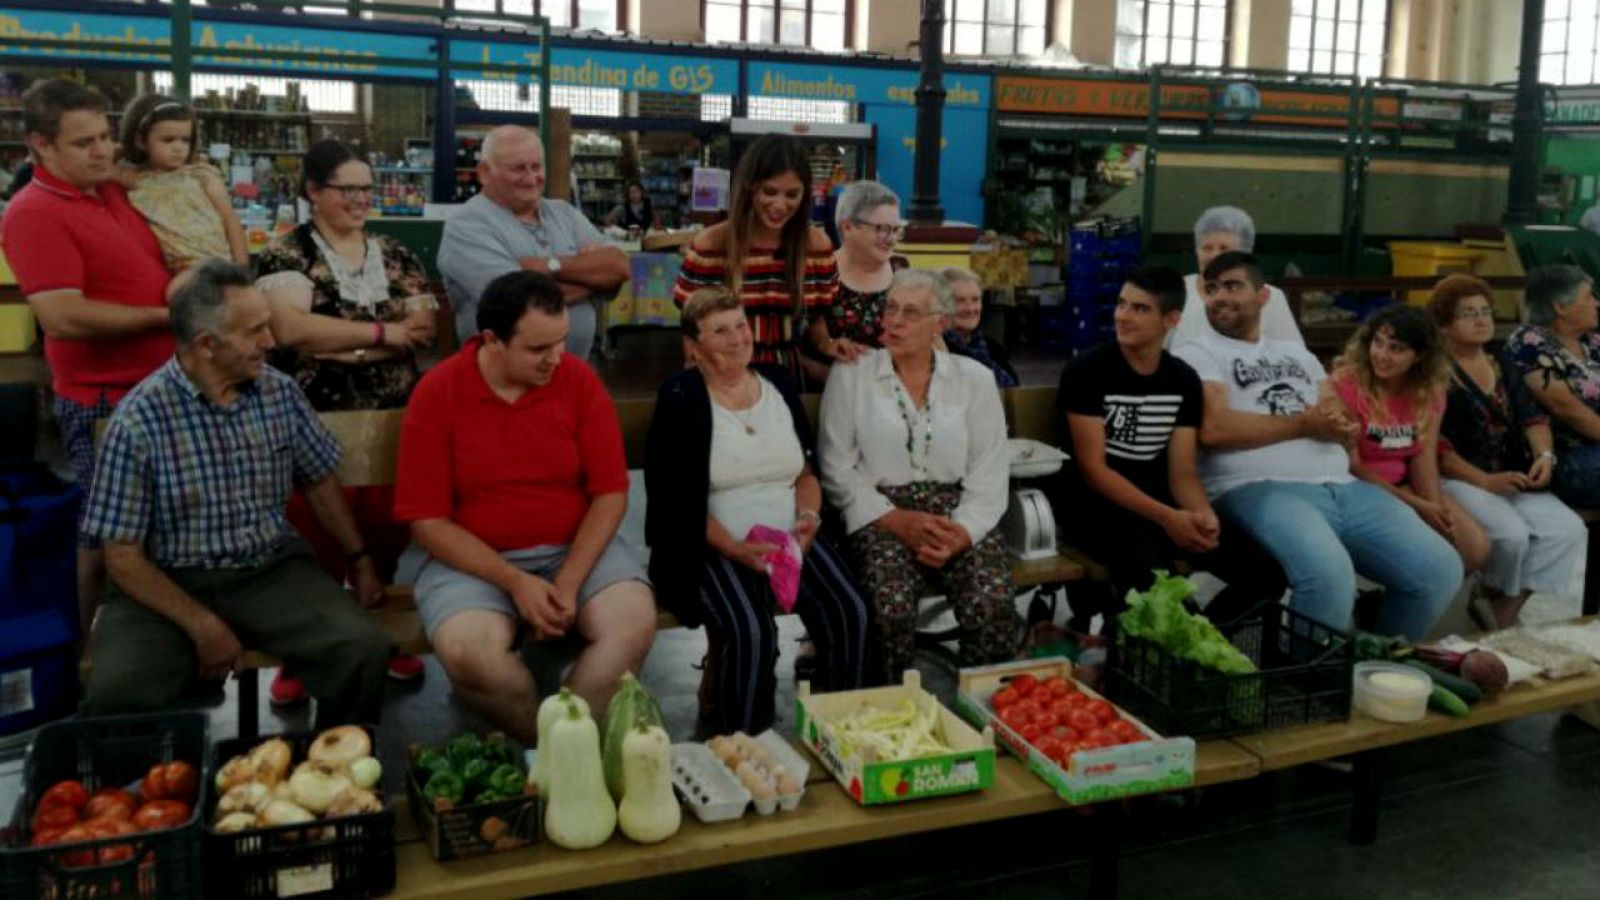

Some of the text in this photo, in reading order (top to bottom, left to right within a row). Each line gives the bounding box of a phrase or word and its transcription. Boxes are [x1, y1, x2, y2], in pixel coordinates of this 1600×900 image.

[633, 62, 659, 88] de
[761, 69, 855, 98] Alimentos
[1103, 404, 1125, 429] 76
